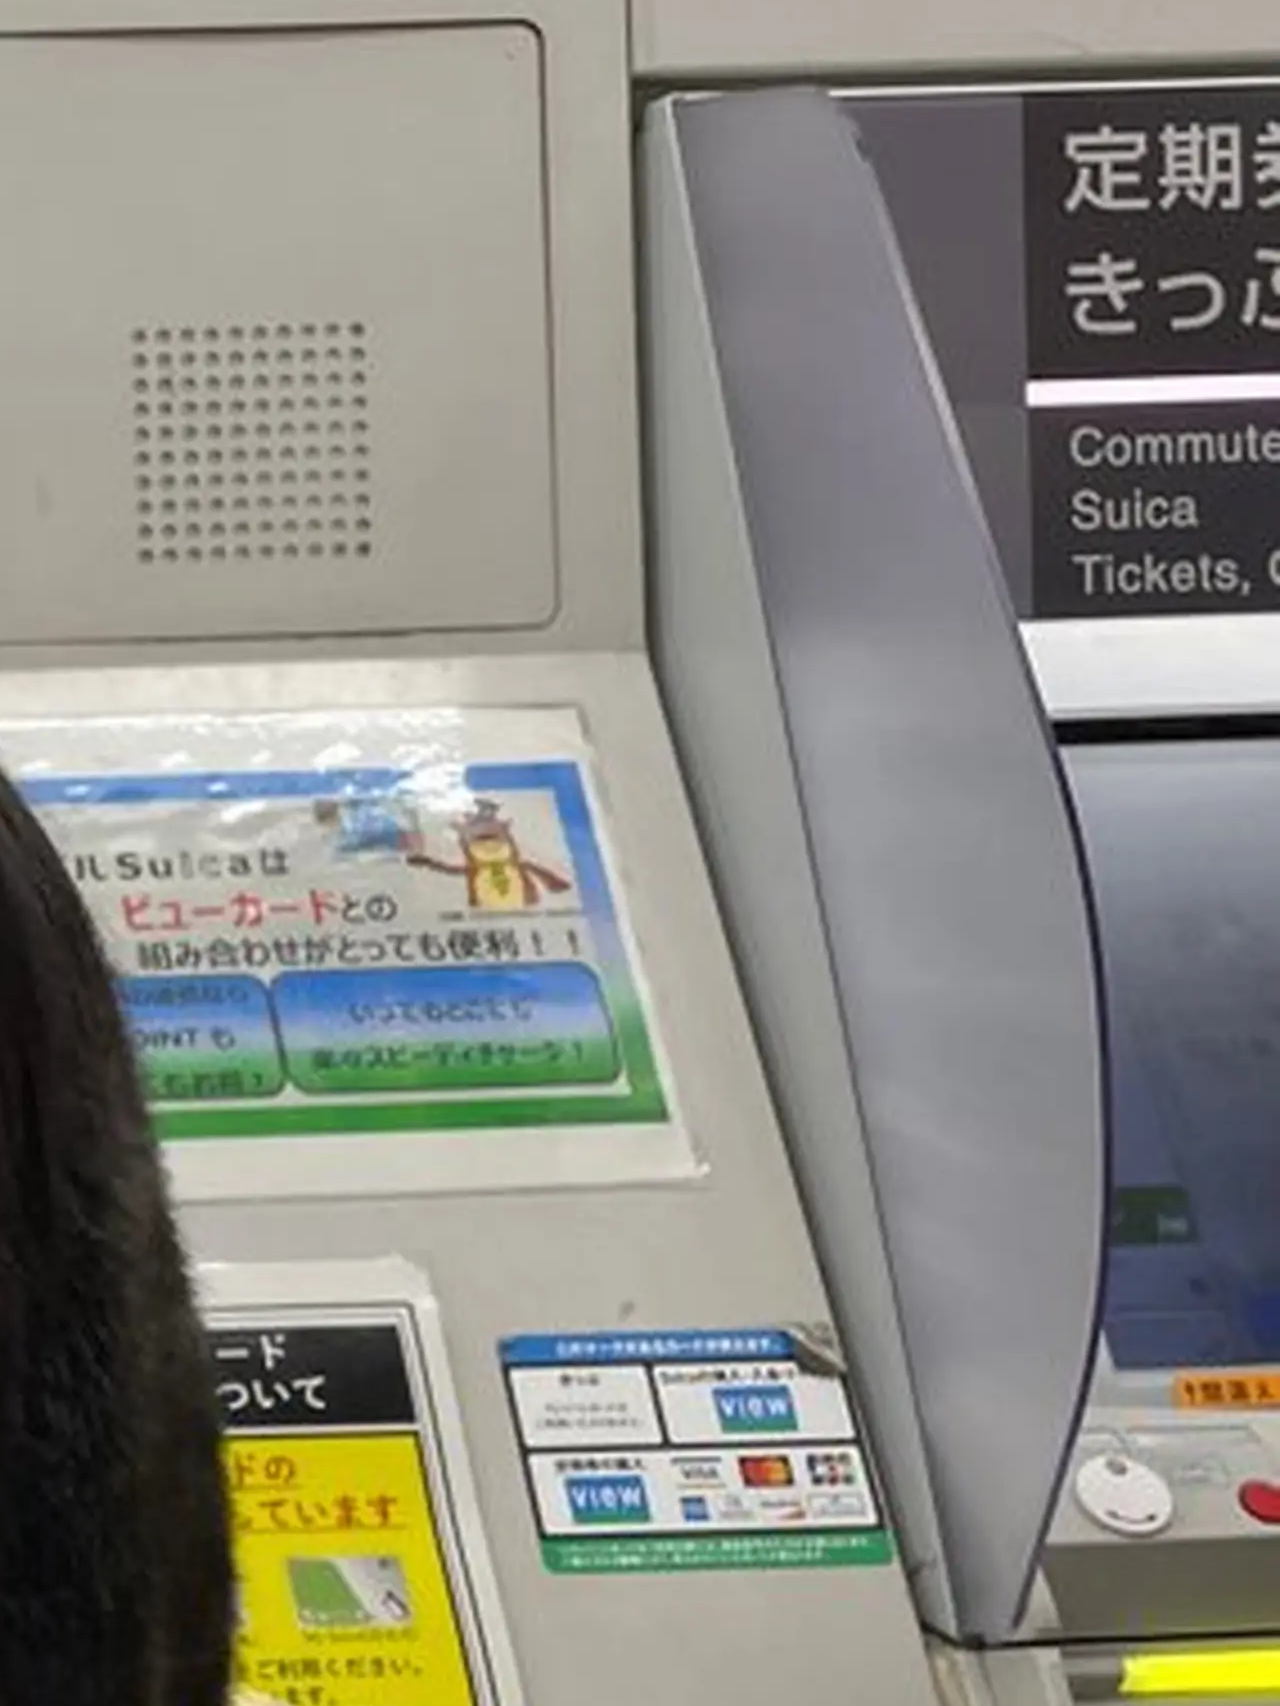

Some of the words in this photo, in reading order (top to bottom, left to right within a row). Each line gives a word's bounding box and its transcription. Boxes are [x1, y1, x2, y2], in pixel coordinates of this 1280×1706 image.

[1070, 488, 1198, 531] Suica
[1073, 552, 1251, 597] Tickets,
[121, 890, 399, 933] ビューカードとの
